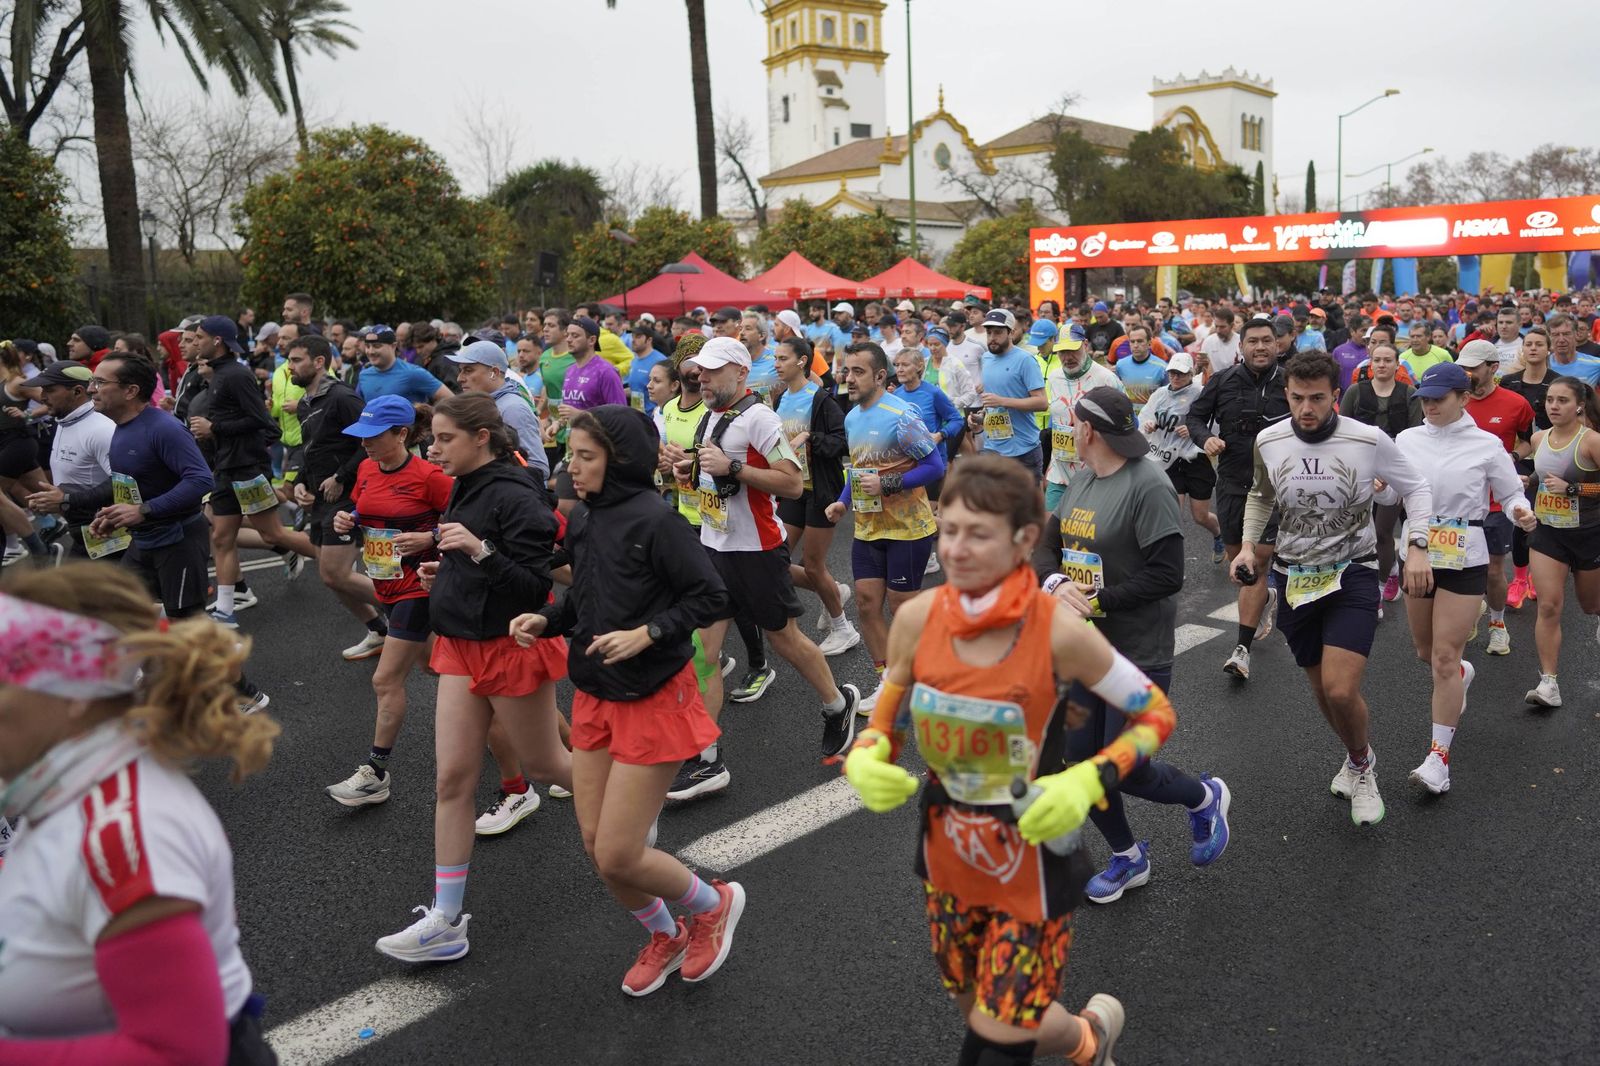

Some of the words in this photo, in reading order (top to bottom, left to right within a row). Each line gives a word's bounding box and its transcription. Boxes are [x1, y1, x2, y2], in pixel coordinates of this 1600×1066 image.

[1453, 217, 1511, 238] HOKA
[1184, 233, 1229, 250] HOKA
[1053, 432, 1075, 448] 16871
[1300, 457, 1325, 476] XL
[1537, 494, 1571, 510] 14765
[1071, 508, 1096, 524] TITAN
[1060, 518, 1096, 541] SABINA
[920, 718, 1009, 758] 13161
[509, 795, 527, 813] HOKA
